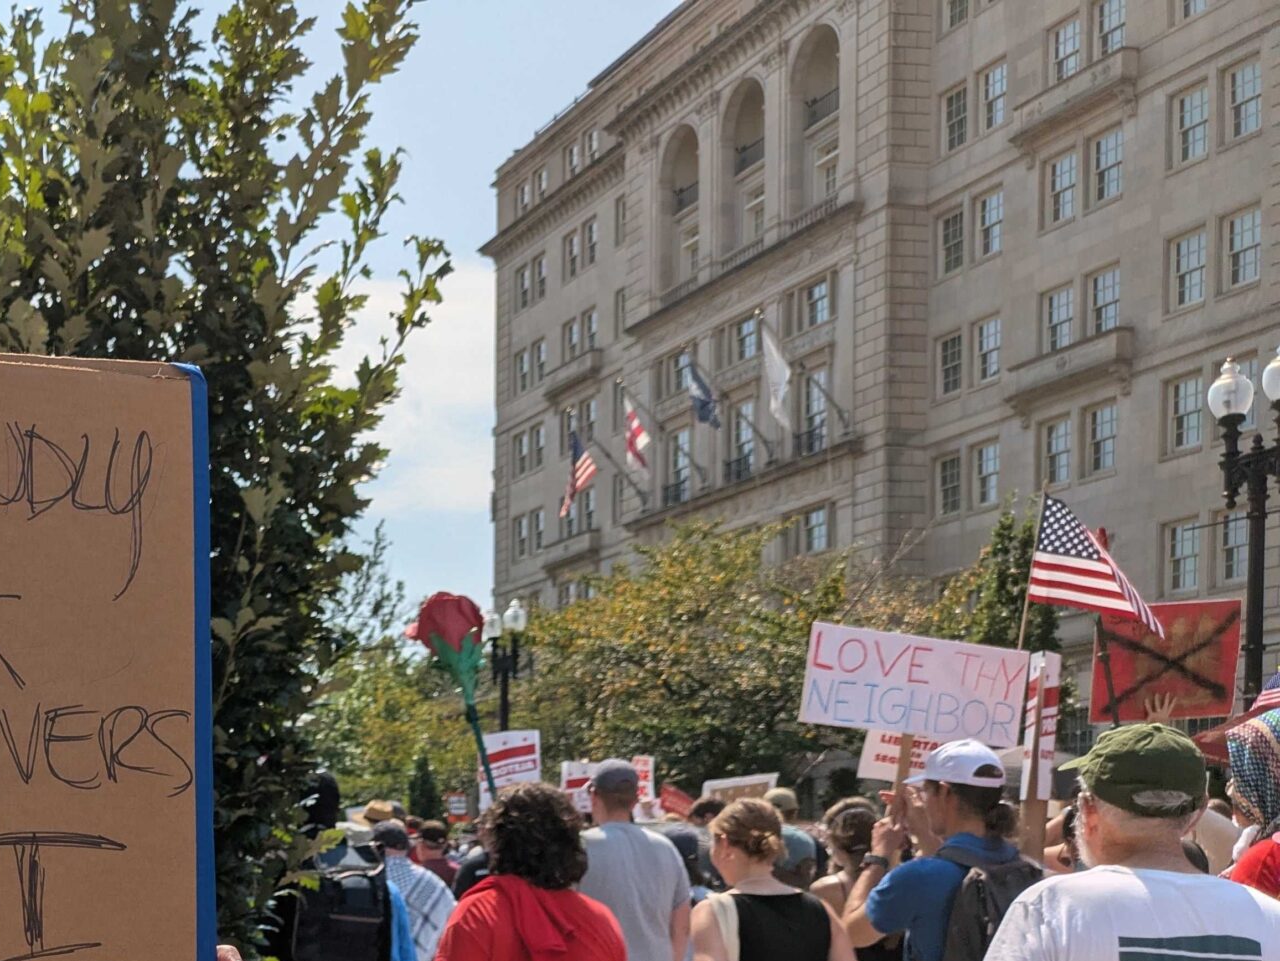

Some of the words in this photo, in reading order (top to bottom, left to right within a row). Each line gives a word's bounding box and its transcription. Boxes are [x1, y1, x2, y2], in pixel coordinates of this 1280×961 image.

[812, 630, 932, 685] LOVE
[954, 651, 1025, 701] THY
[807, 678, 1016, 742] NEIGHBOR
